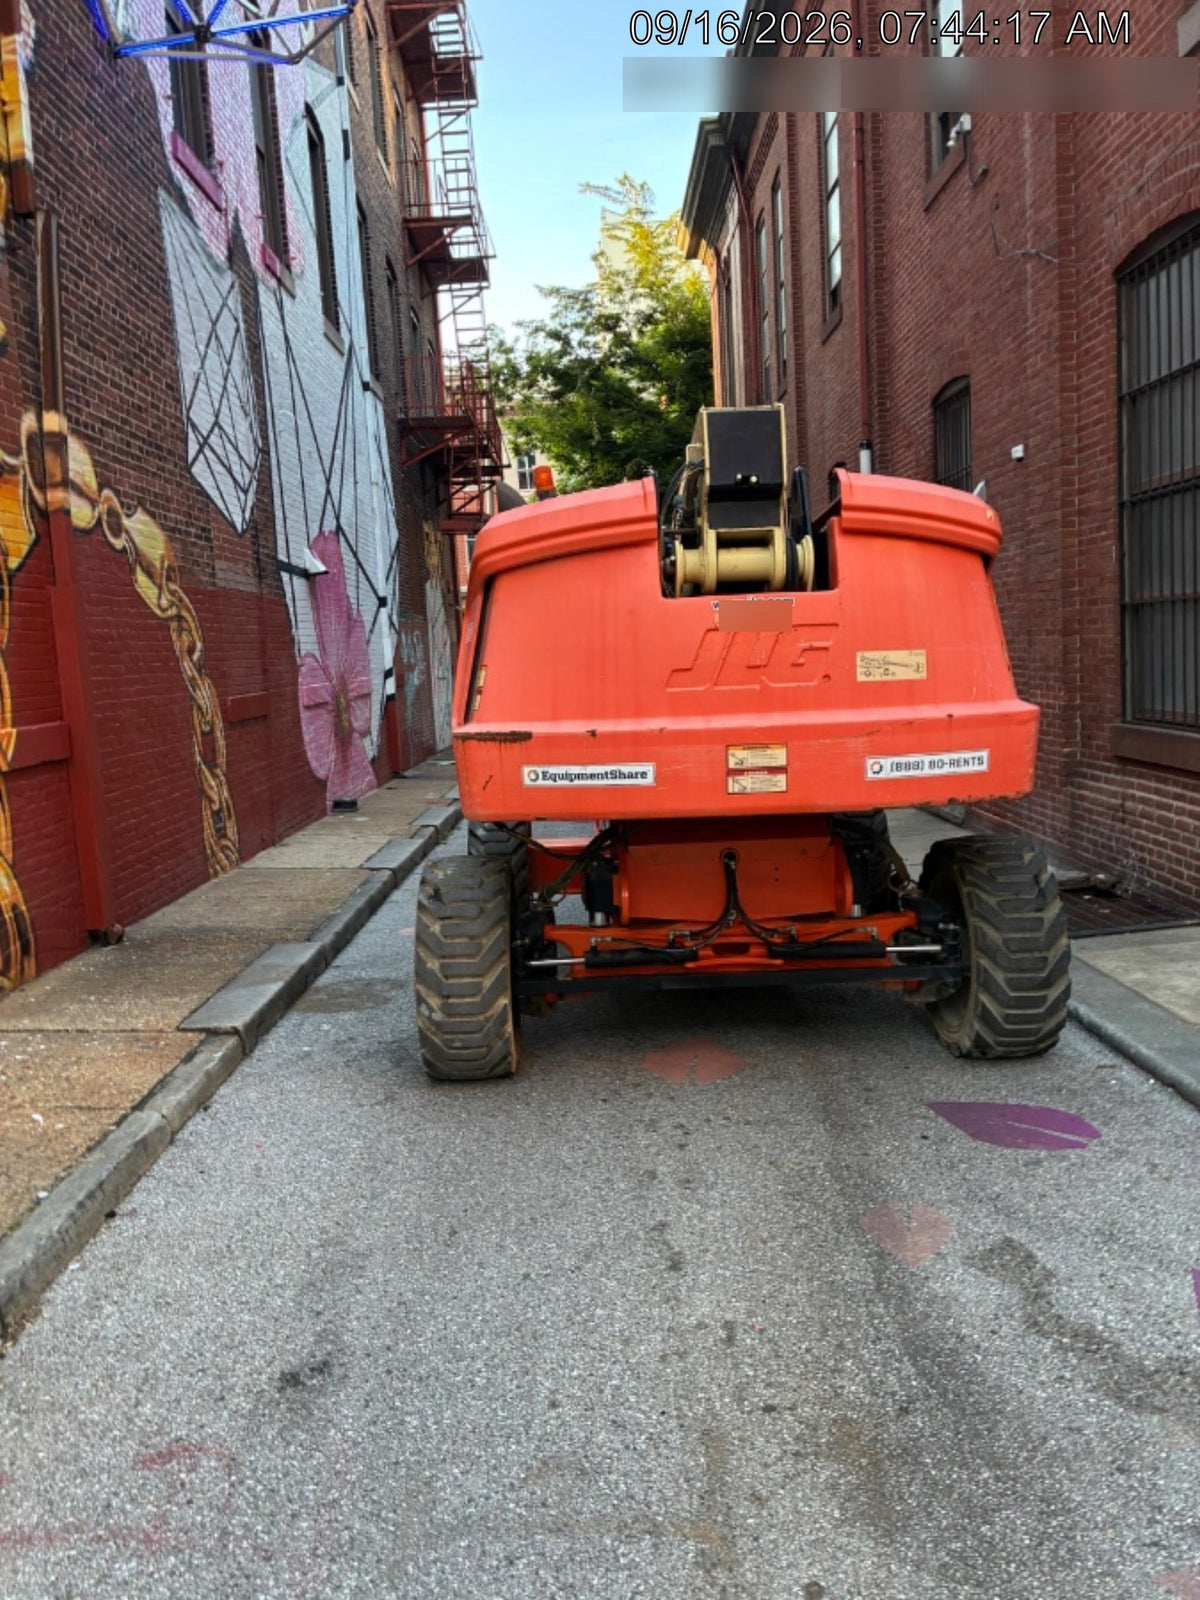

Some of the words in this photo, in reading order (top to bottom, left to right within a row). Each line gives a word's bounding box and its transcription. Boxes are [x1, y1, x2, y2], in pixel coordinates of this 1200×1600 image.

[666, 622, 839, 692] JLG
[890, 760, 925, 773] (888)
[928, 755, 984, 770] 80-RENTS
[541, 768, 649, 783] EquipmentShare
